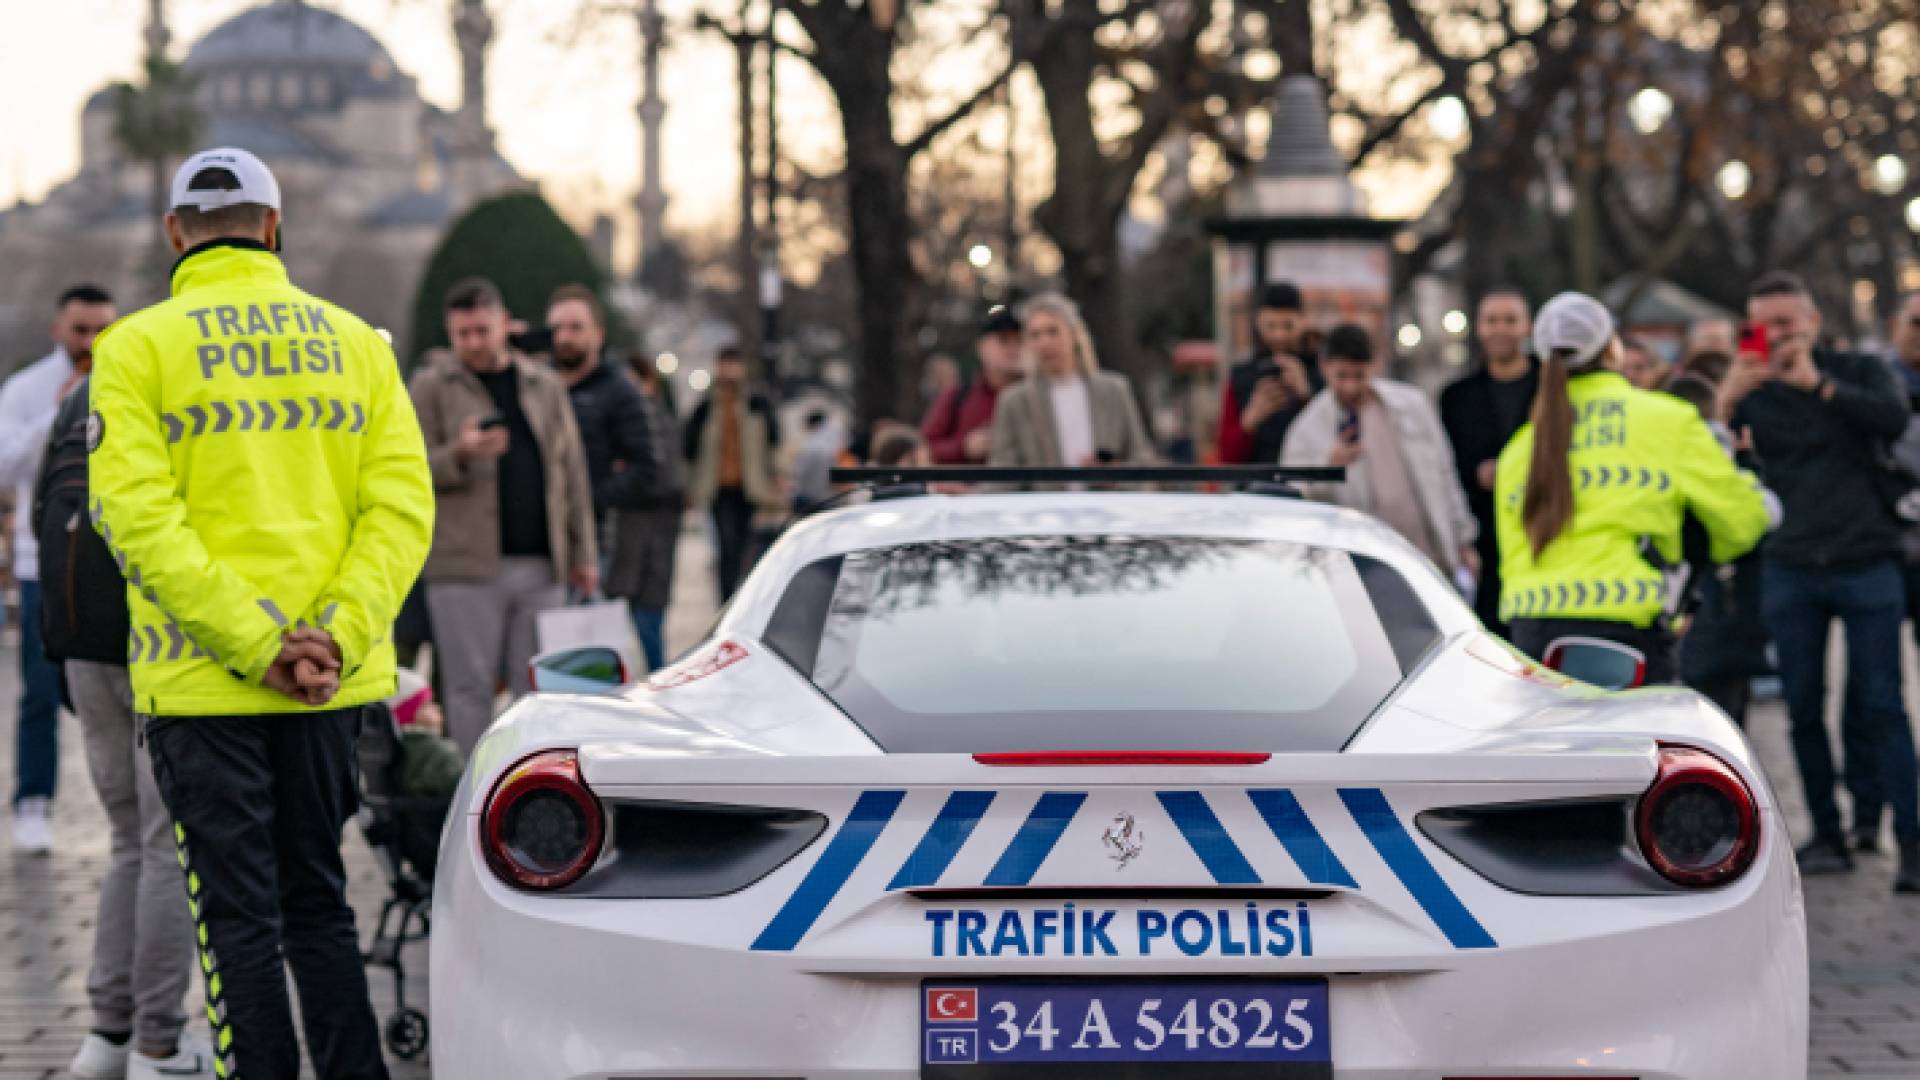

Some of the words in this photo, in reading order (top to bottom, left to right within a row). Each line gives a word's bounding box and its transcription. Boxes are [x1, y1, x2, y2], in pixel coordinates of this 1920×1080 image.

[925, 901, 1119, 957] TRAFİK
[1136, 901, 1313, 957] POLİSİ
[936, 1036, 968, 1057] TR
[987, 999, 1060, 1052] 34
[1070, 998, 1122, 1049] A
[1133, 998, 1314, 1051] 54825
